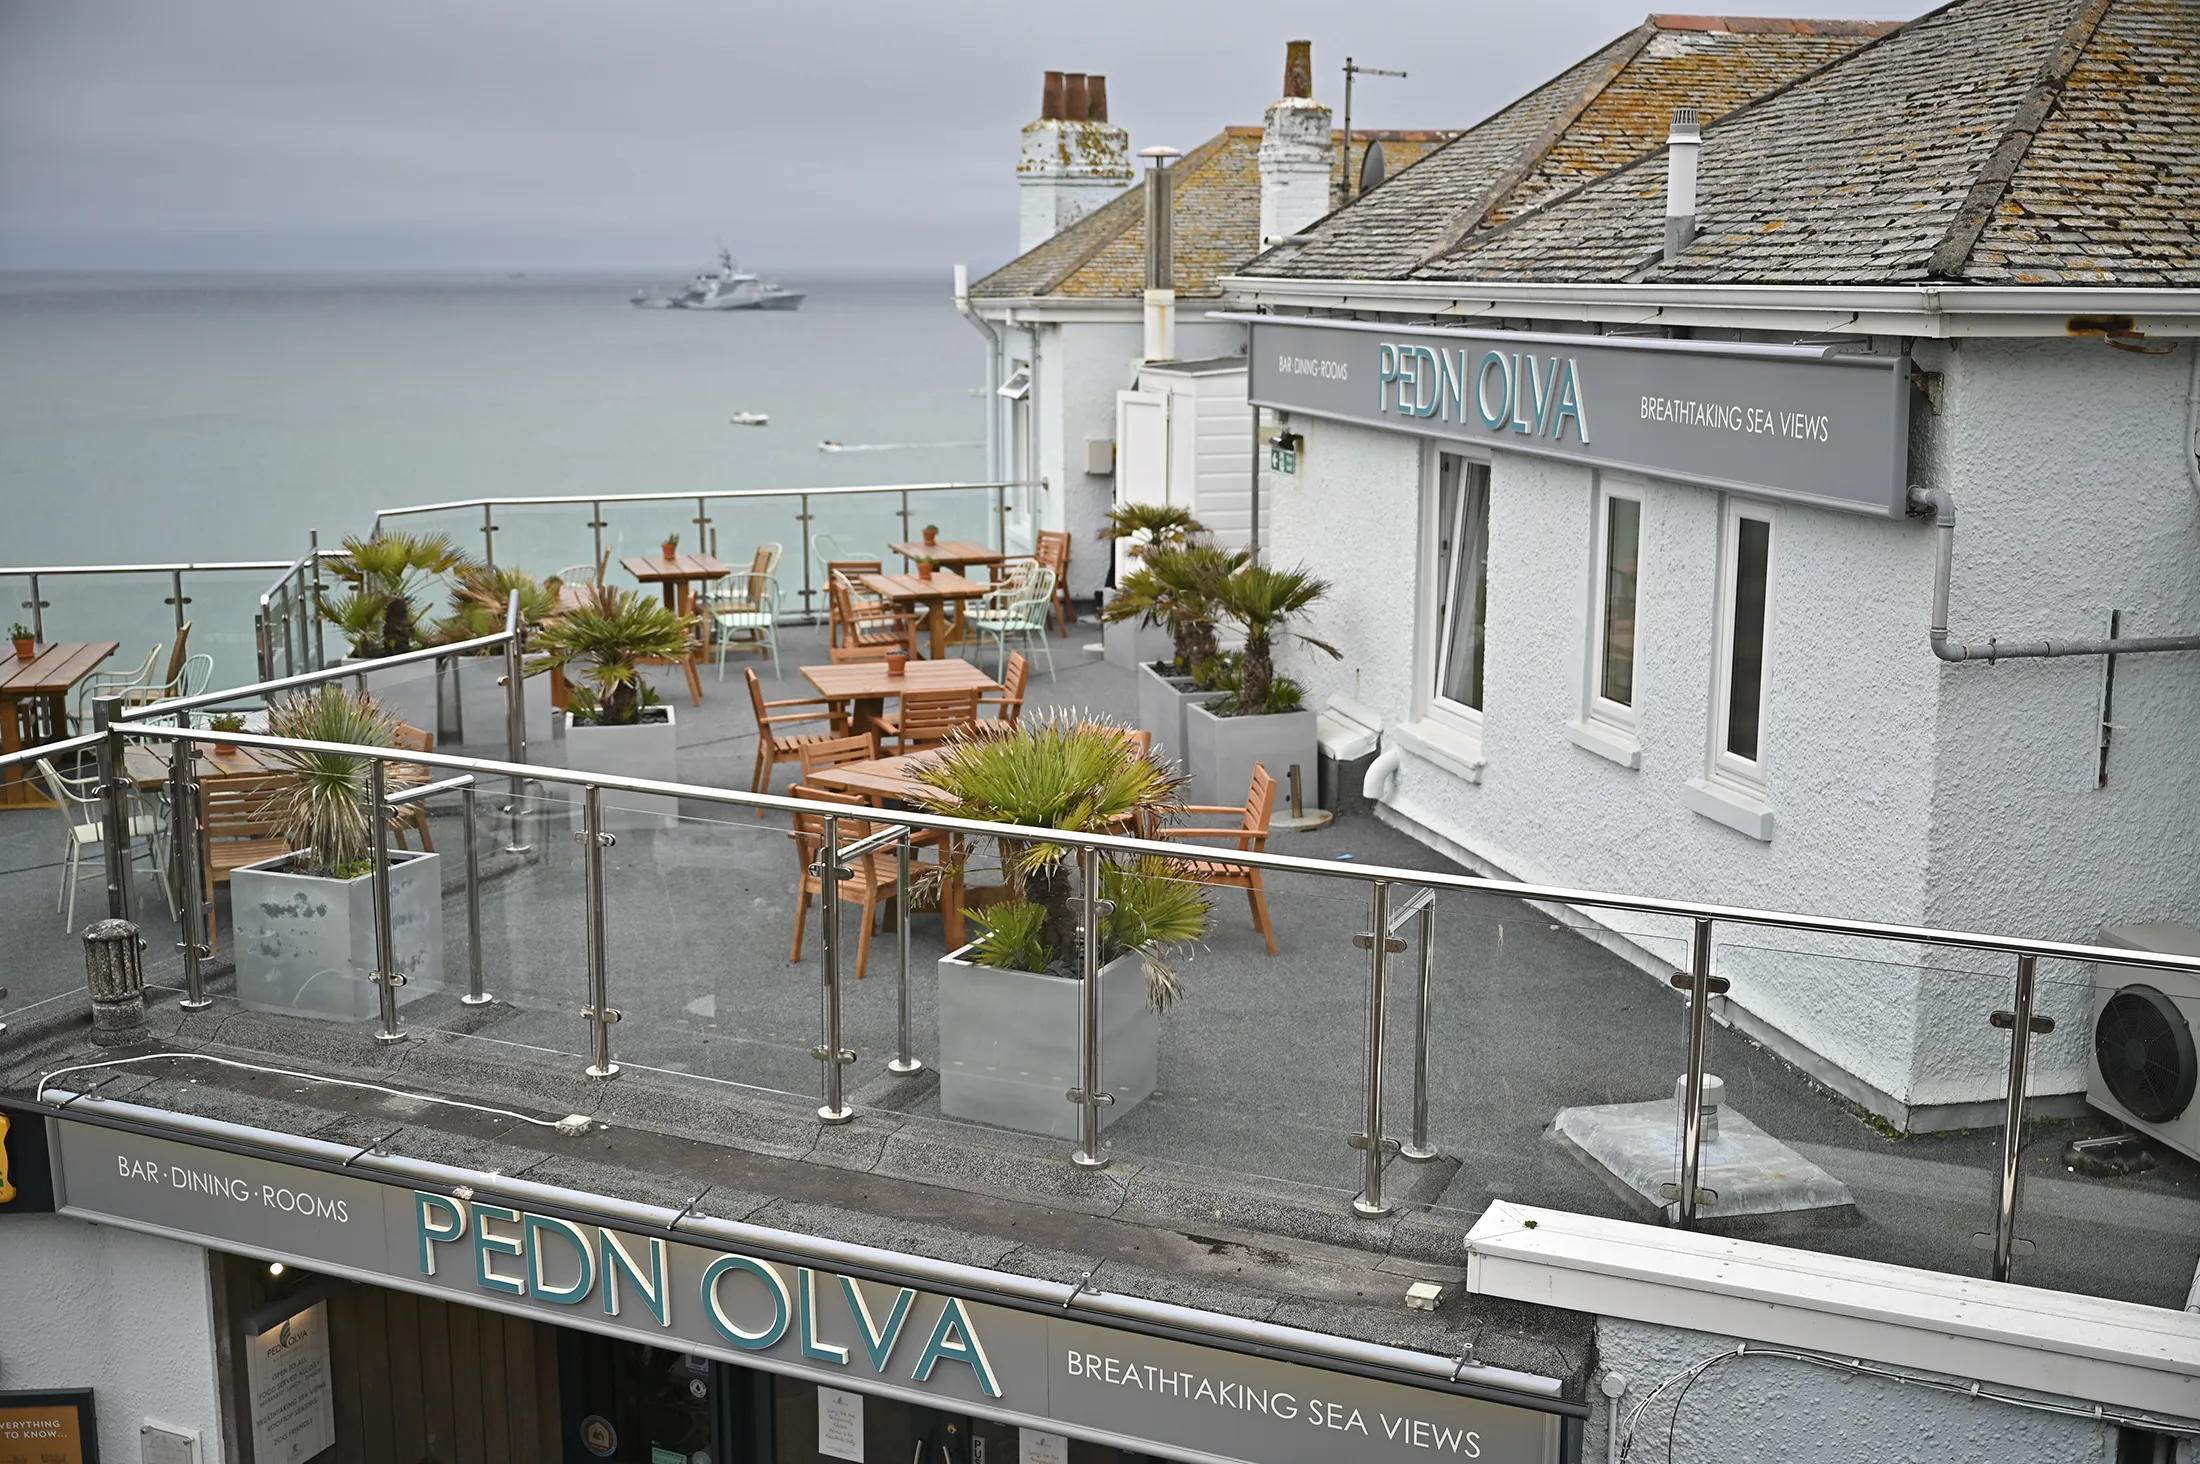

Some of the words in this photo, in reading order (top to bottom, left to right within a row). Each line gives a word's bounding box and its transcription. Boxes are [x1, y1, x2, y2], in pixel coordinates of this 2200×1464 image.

[1379, 342, 1468, 424] PEDN
[1477, 350, 1590, 444] OLVA
[1640, 396, 1743, 431] BREATHTAKING
[1745, 407, 1775, 435] SEA
[1780, 411, 1829, 443] VIEWS
[414, 1190, 671, 1327] PEDN
[700, 1253, 1002, 1398] OLVA
[4, 1431, 19, 1439] TO
[1067, 1350, 1298, 1419] BREATHTAKING
[1308, 1399, 1369, 1436] SEA
[1379, 1413, 1481, 1459] VIEWS
